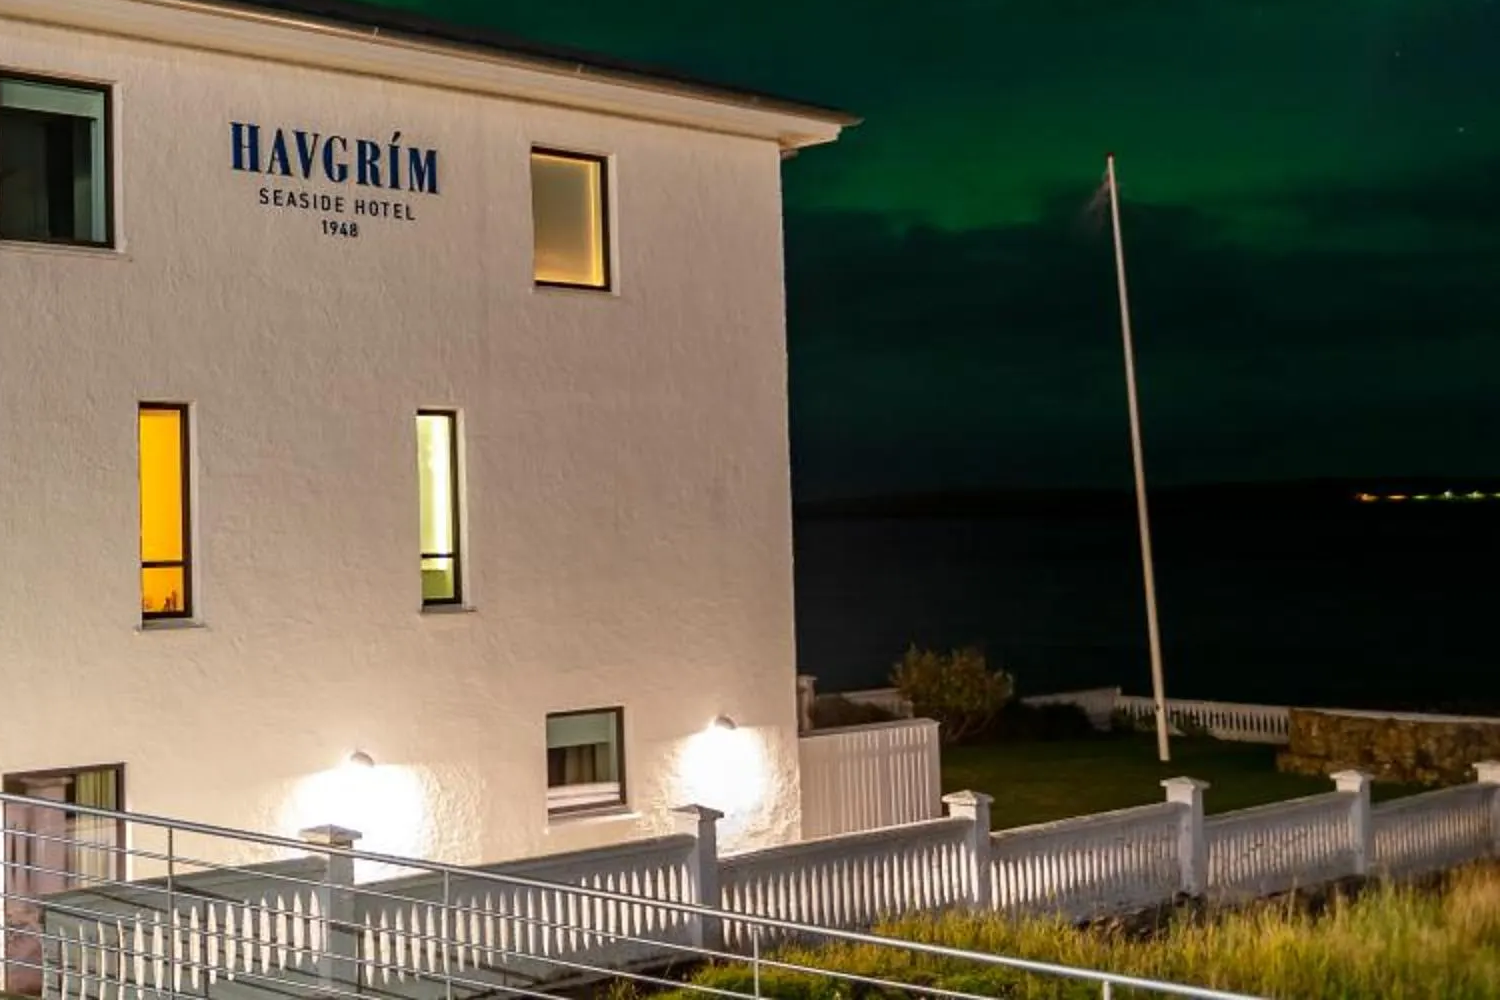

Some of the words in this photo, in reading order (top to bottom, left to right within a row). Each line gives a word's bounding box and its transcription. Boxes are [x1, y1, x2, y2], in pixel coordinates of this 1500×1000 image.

[229, 121, 439, 194] HAVGRÍM
[259, 187, 345, 213] SEASIDE
[354, 199, 416, 221] HOTEL
[322, 219, 359, 238] 1948
